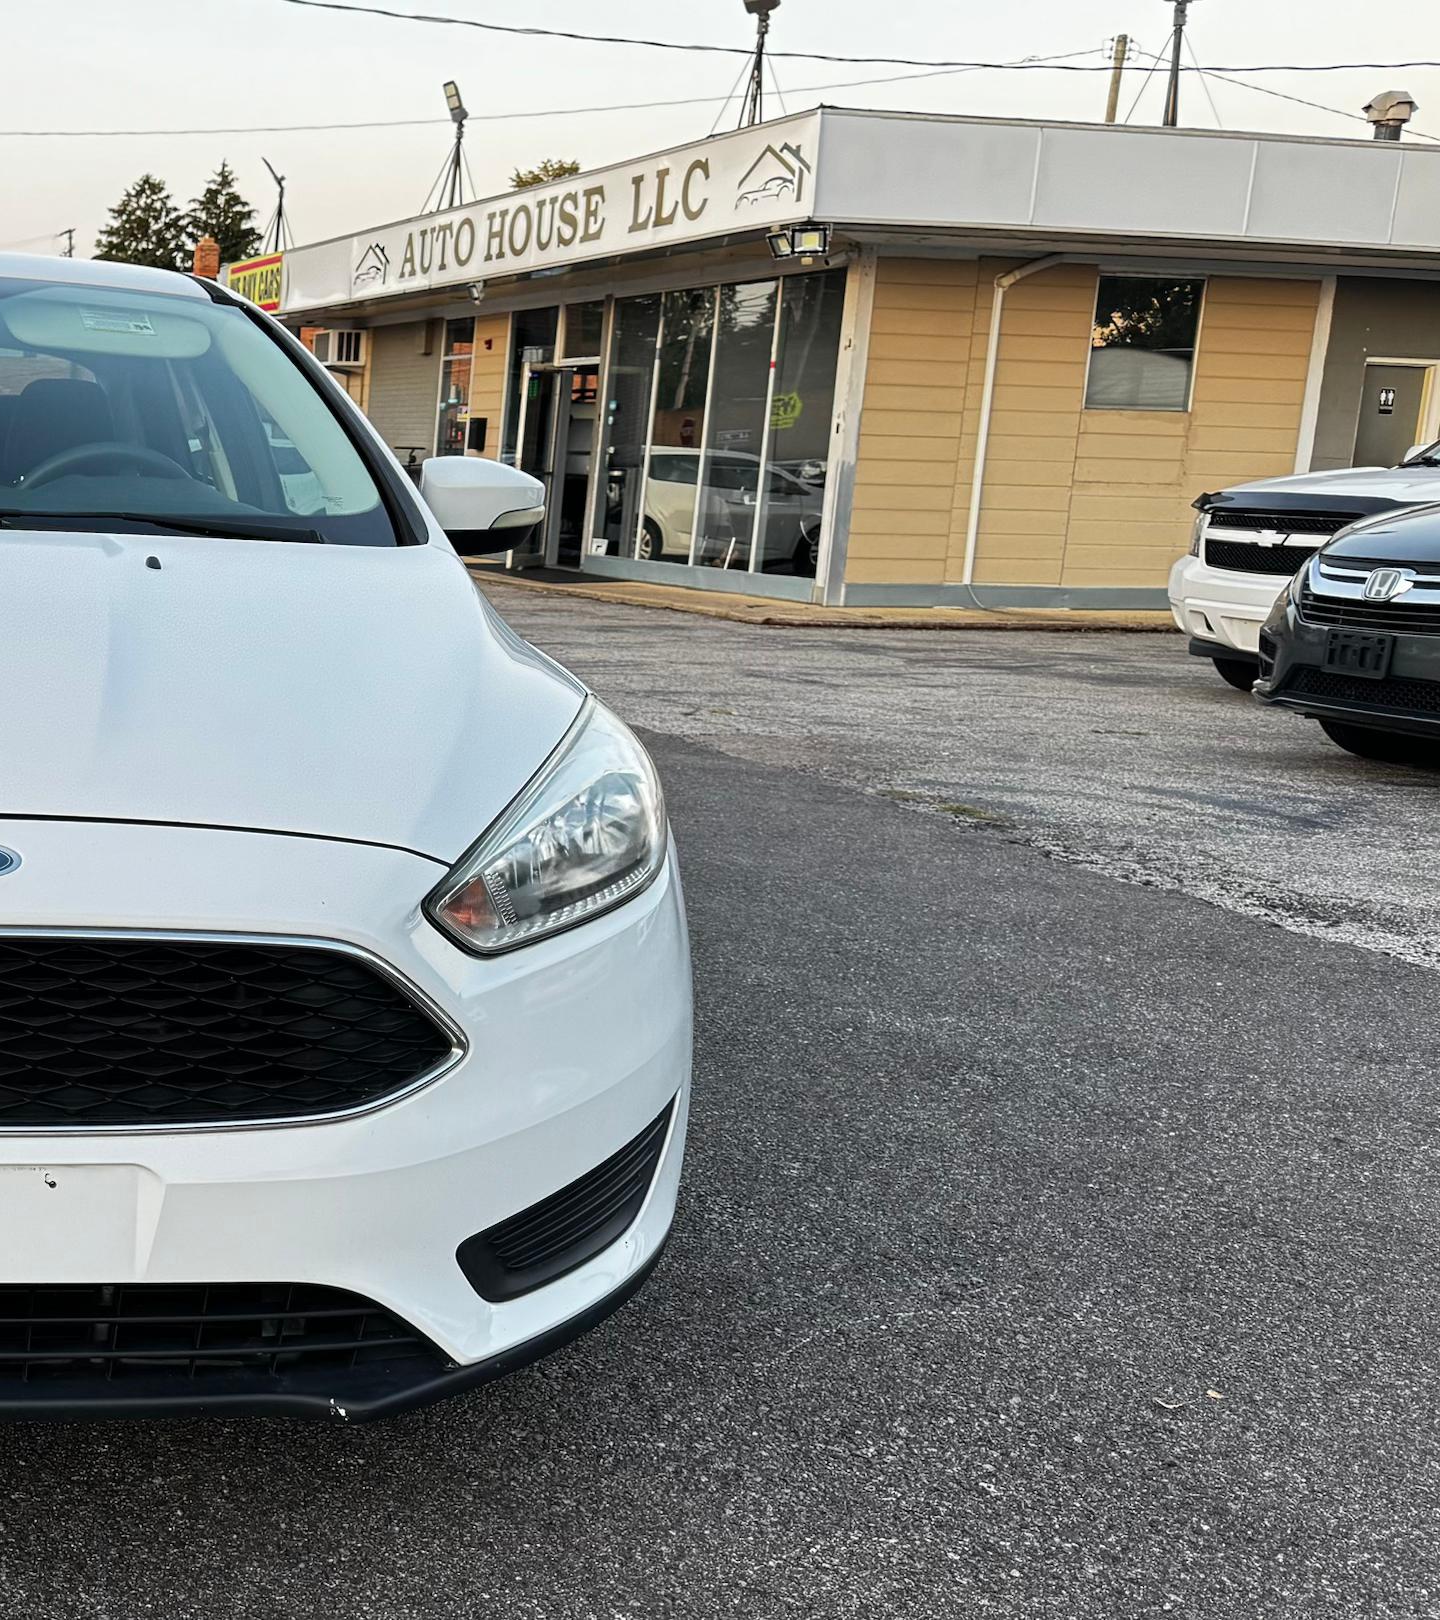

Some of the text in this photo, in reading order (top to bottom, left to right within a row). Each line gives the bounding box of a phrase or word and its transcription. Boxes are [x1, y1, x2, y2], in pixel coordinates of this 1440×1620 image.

[399, 157, 710, 279] AUTO HOUSE LLC
[258, 267, 280, 301] CARS
